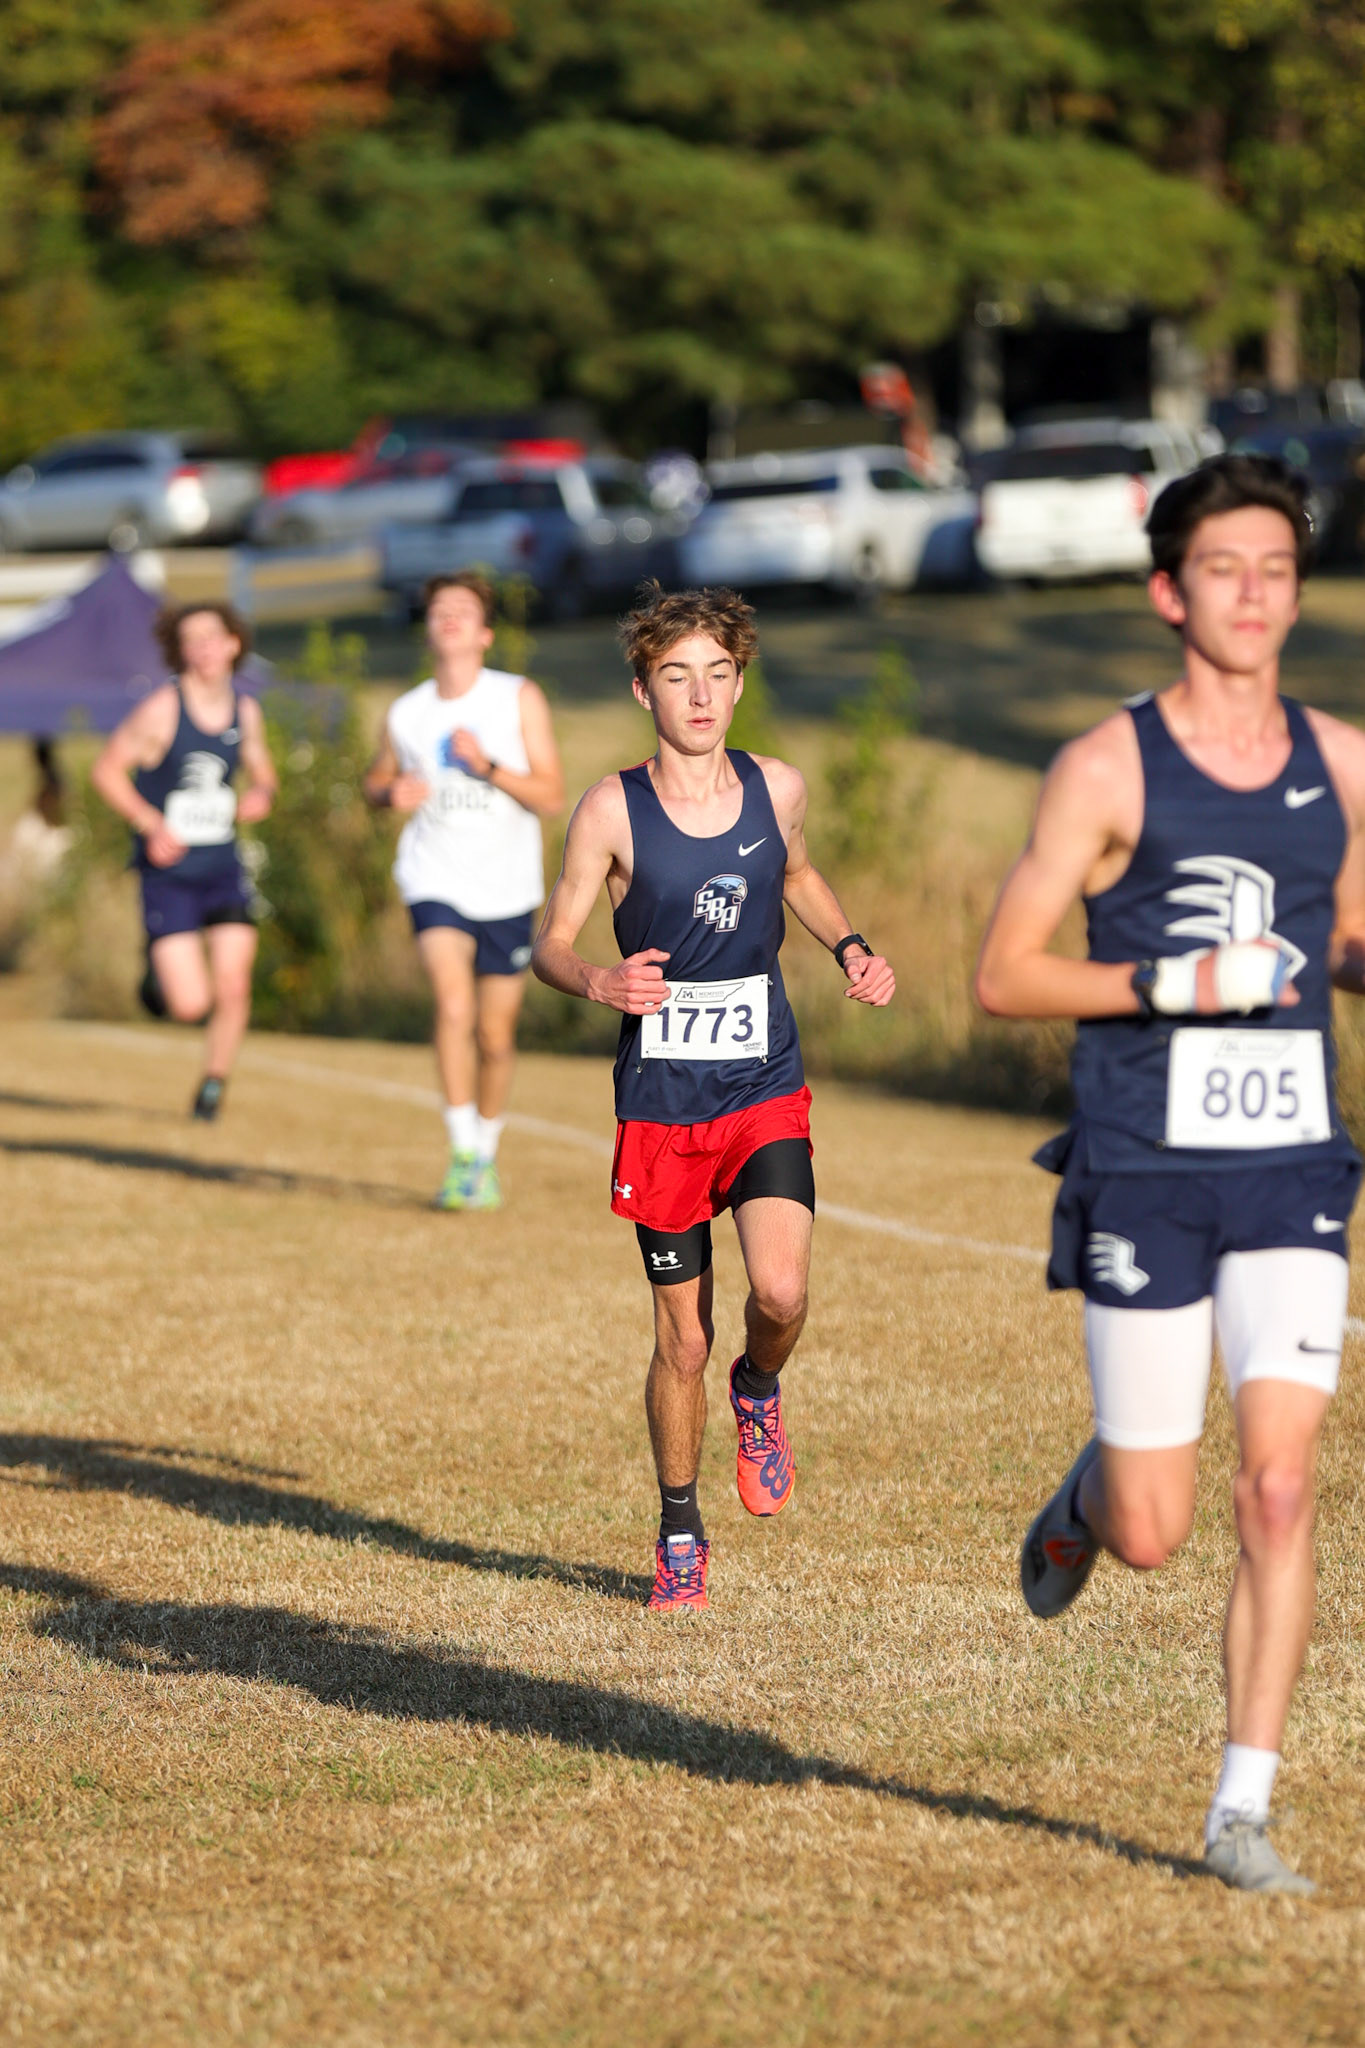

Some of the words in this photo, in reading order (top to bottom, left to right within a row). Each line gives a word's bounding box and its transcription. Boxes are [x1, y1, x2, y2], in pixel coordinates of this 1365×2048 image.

[696, 889, 738, 929] SBA
[657, 1004, 754, 1044] 1773
[1202, 1068, 1299, 1120] 805
